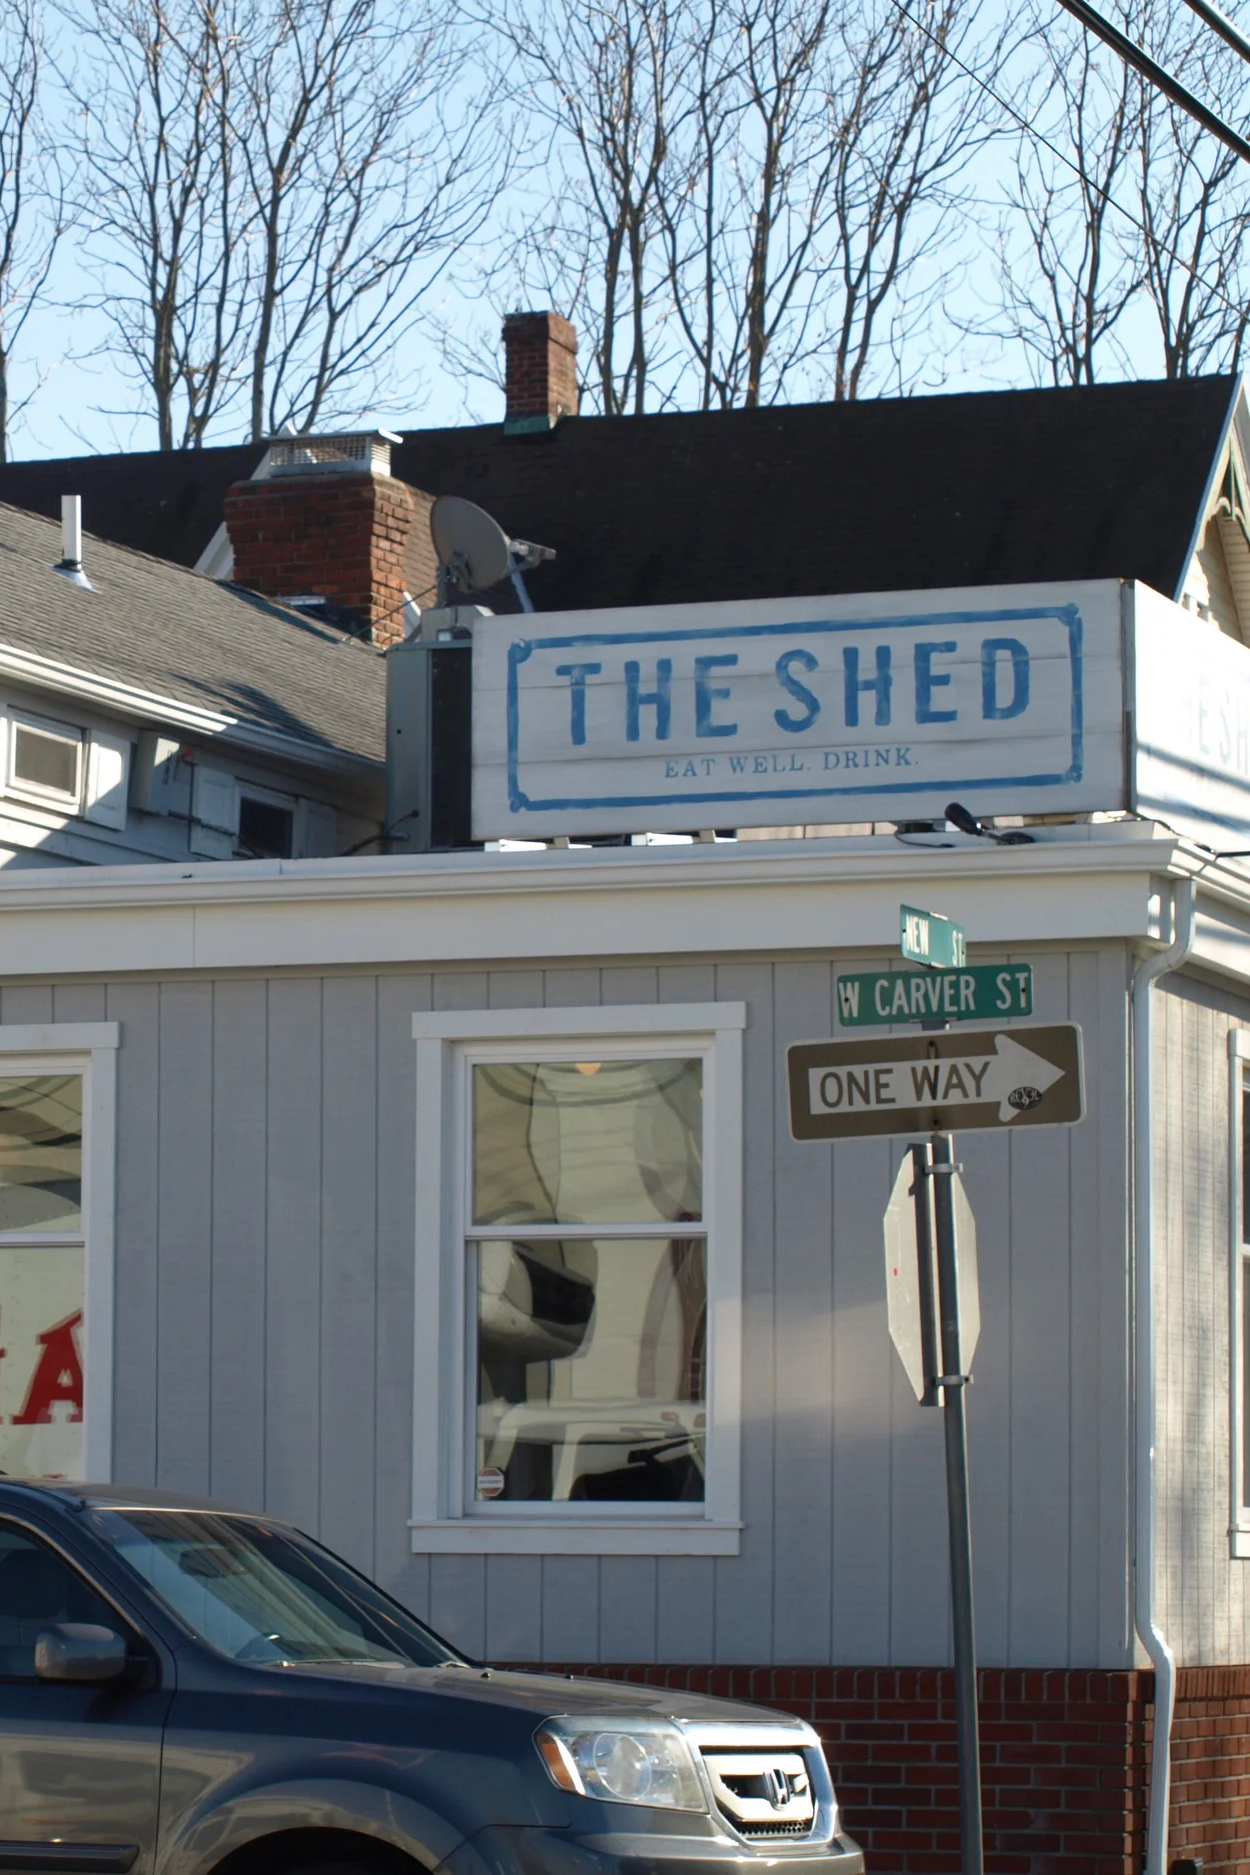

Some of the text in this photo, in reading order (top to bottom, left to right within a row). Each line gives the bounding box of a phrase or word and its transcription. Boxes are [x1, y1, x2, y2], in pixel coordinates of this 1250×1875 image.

[555, 637, 1031, 746] THE SHED
[664, 747, 919, 778] EAT WELL. DRINK.
[904, 914, 930, 956] NEW
[838, 970, 1029, 1018] W CARVER ST
[819, 1060, 991, 1109] ONE WAY
